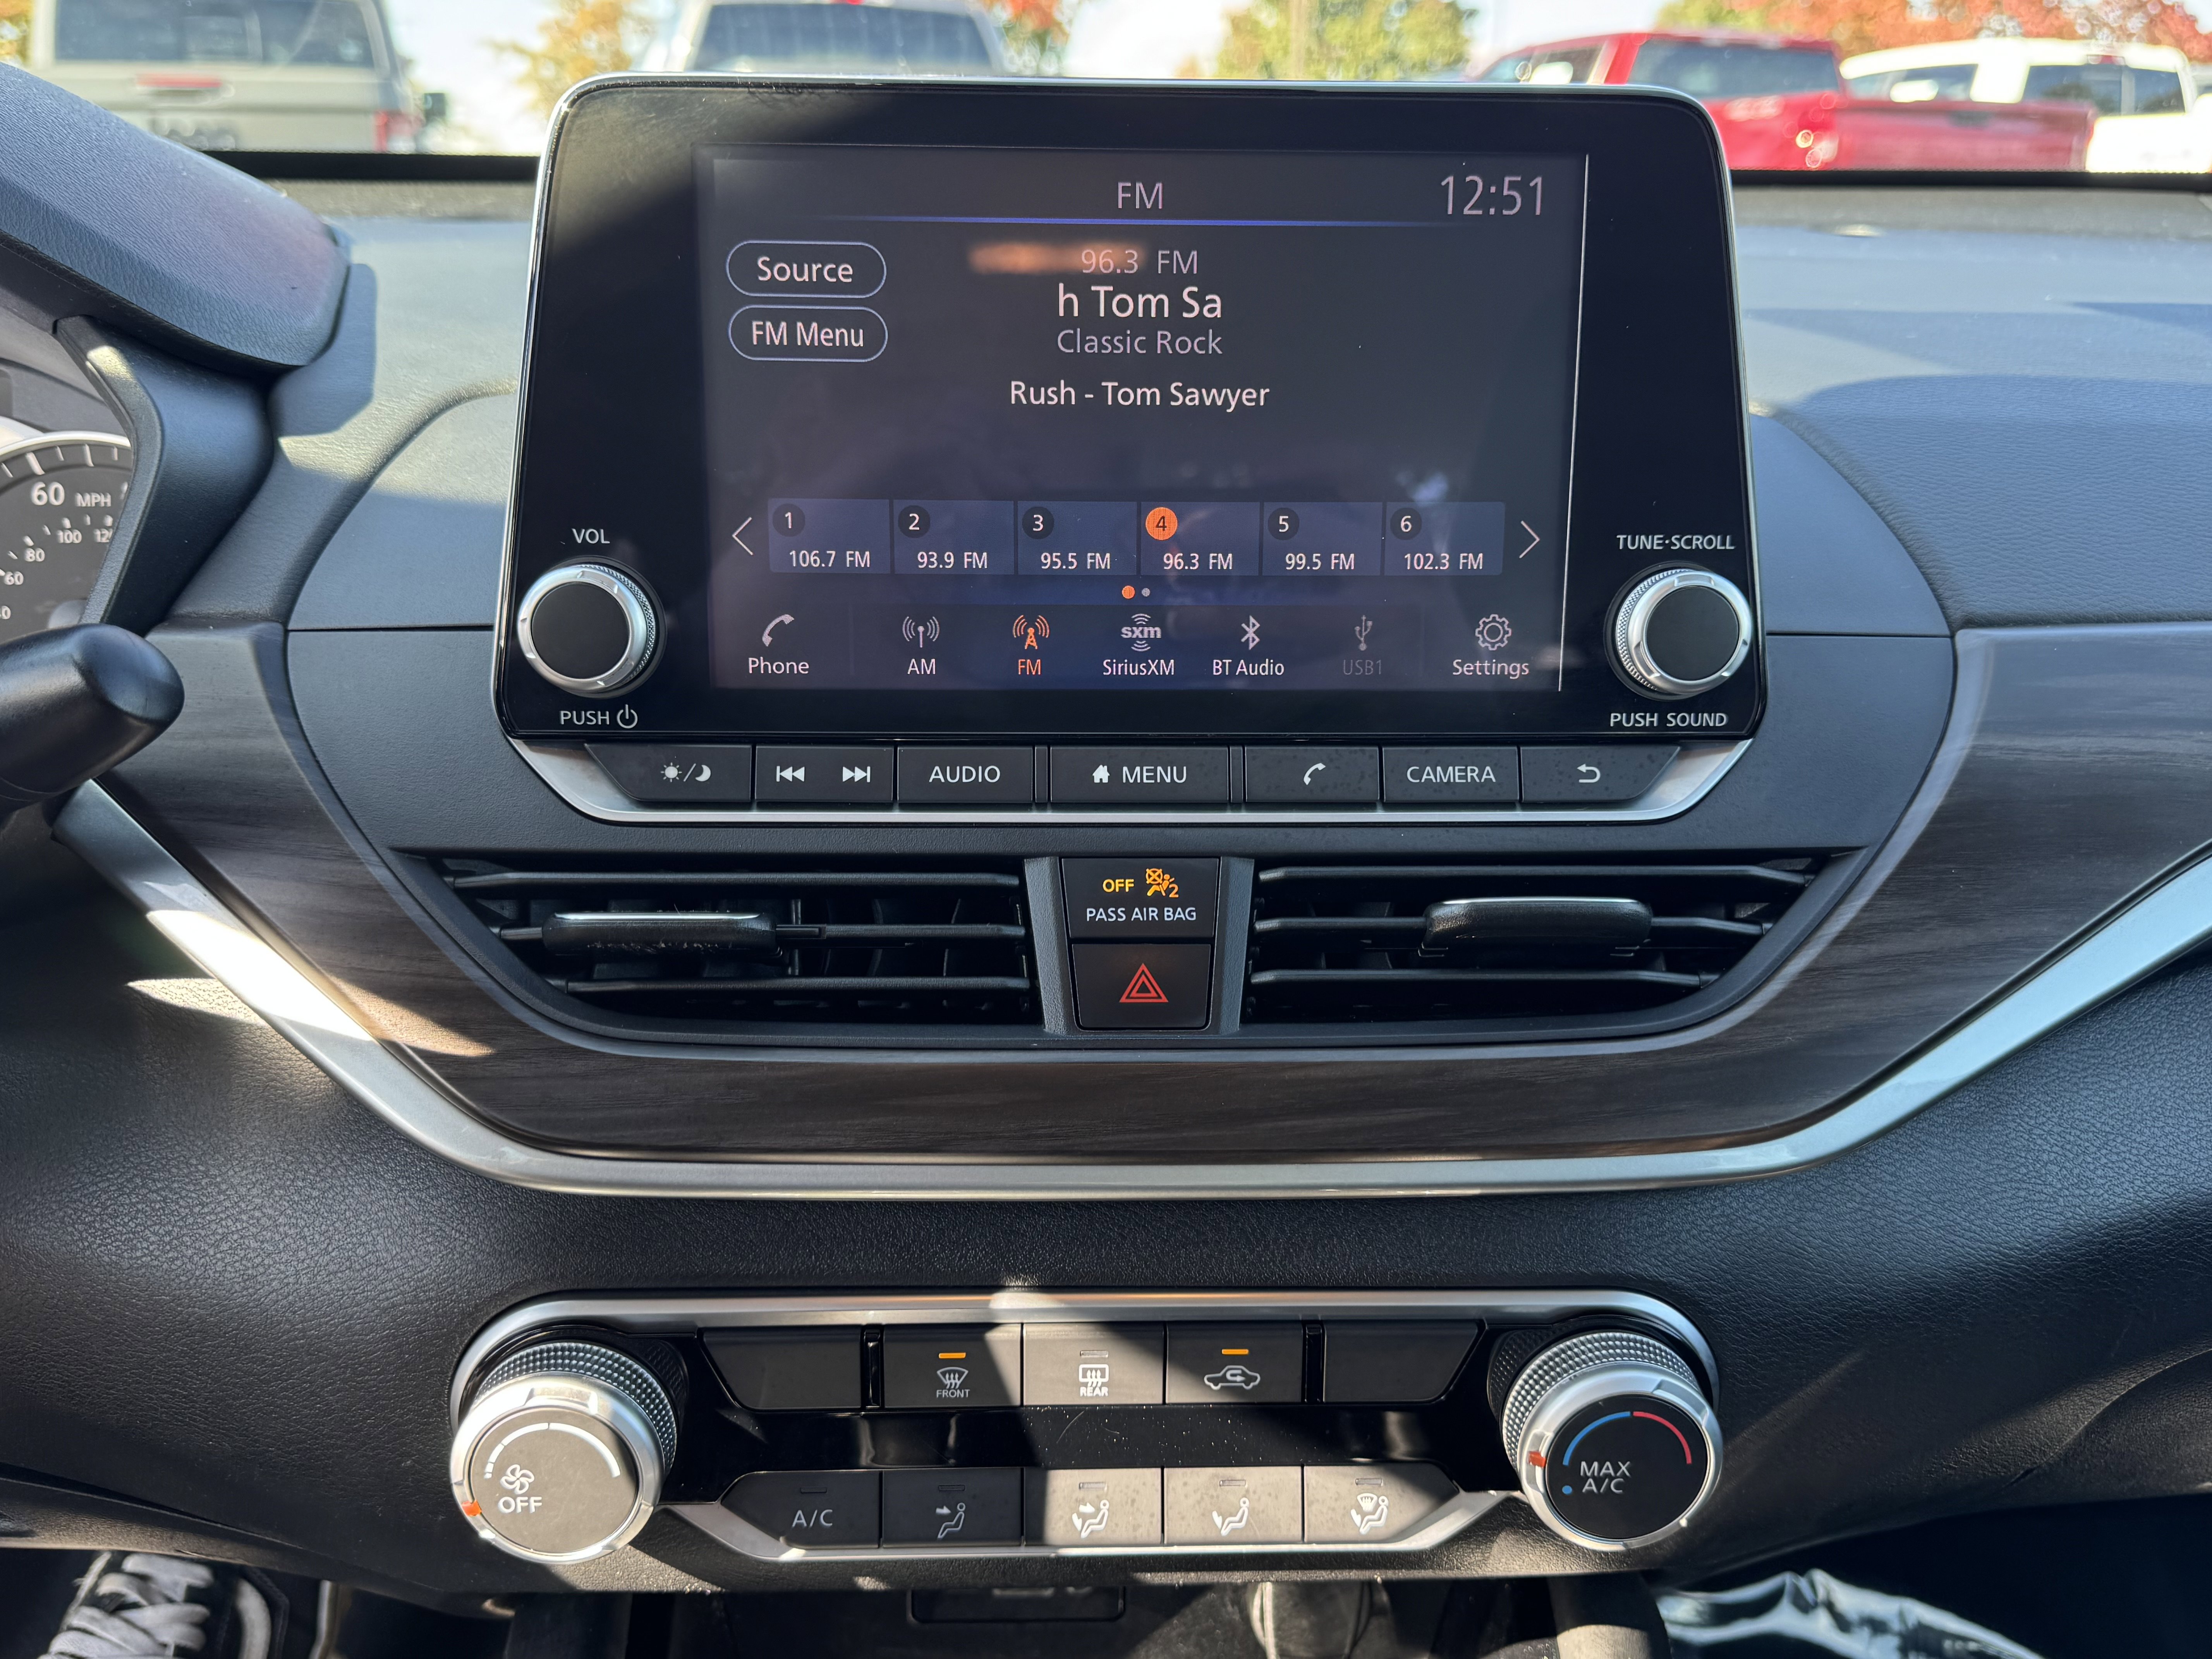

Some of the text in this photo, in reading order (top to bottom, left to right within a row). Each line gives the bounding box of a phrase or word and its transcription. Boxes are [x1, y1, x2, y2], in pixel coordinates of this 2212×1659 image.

[1117, 182, 1163, 209] FM
[1441, 175, 1543, 215] 12:51
[757, 256, 854, 283] Source
[1081, 249, 1198, 275] 96.3 FM
[1058, 283, 1222, 318] h Tom Sa
[752, 321, 864, 347] FM Menu
[1057, 328, 1223, 354] Classic Rock
[1011, 380, 1075, 405] Rush
[1101, 381, 1161, 405] Tom
[1170, 382, 1270, 413] Sawyer
[31, 482, 65, 505] 60
[76, 493, 111, 507] MPH
[784, 512, 793, 528] 1
[909, 514, 920, 530] 2
[1033, 514, 1044, 531] 3
[1156, 516, 1167, 532] 4
[1278, 516, 1289, 532] 5
[1400, 516, 1412, 532] 6
[57, 529, 82, 543] 100
[572, 528, 610, 544] VOL
[24, 548, 45, 562] 80
[789, 550, 870, 568] 106.7 FM
[917, 551, 988, 568] 93.9 FM
[1041, 552, 1111, 570] 95.5 FM
[1163, 553, 1233, 570] 96.3 FM
[1285, 553, 1354, 570] 99.5 FM
[1404, 553, 1483, 570] 102.3 FM
[4, 572, 24, 585] 60
[0, 605, 11, 620] 0
[749, 657, 809, 675] Phone
[907, 658, 936, 675] AM
[1018, 659, 1041, 675] FM
[1103, 659, 1175, 676] SiriusXM
[1212, 658, 1285, 676] BT Audio
[1343, 659, 1382, 676] USB1
[1453, 659, 1529, 680] Settings
[560, 711, 610, 725] PUSH
[1610, 713, 1728, 727] PUSH SOUND
[929, 765, 1000, 783] AUDIO
[1123, 766, 1187, 783] MENU
[1407, 766, 1496, 783] CAMERA
[1103, 879, 1134, 892] OFF
[1169, 884, 1179, 898] 2
[1087, 907, 1196, 921] PASS AIR BAG
[936, 1389, 970, 1398] FRONT
[1080, 1387, 1108, 1397] REAR
[1580, 1460, 1631, 1476] MAX
[1582, 1478, 1624, 1494] A/C
[497, 1496, 542, 1514] OFF
[791, 1509, 833, 1528] A/C
